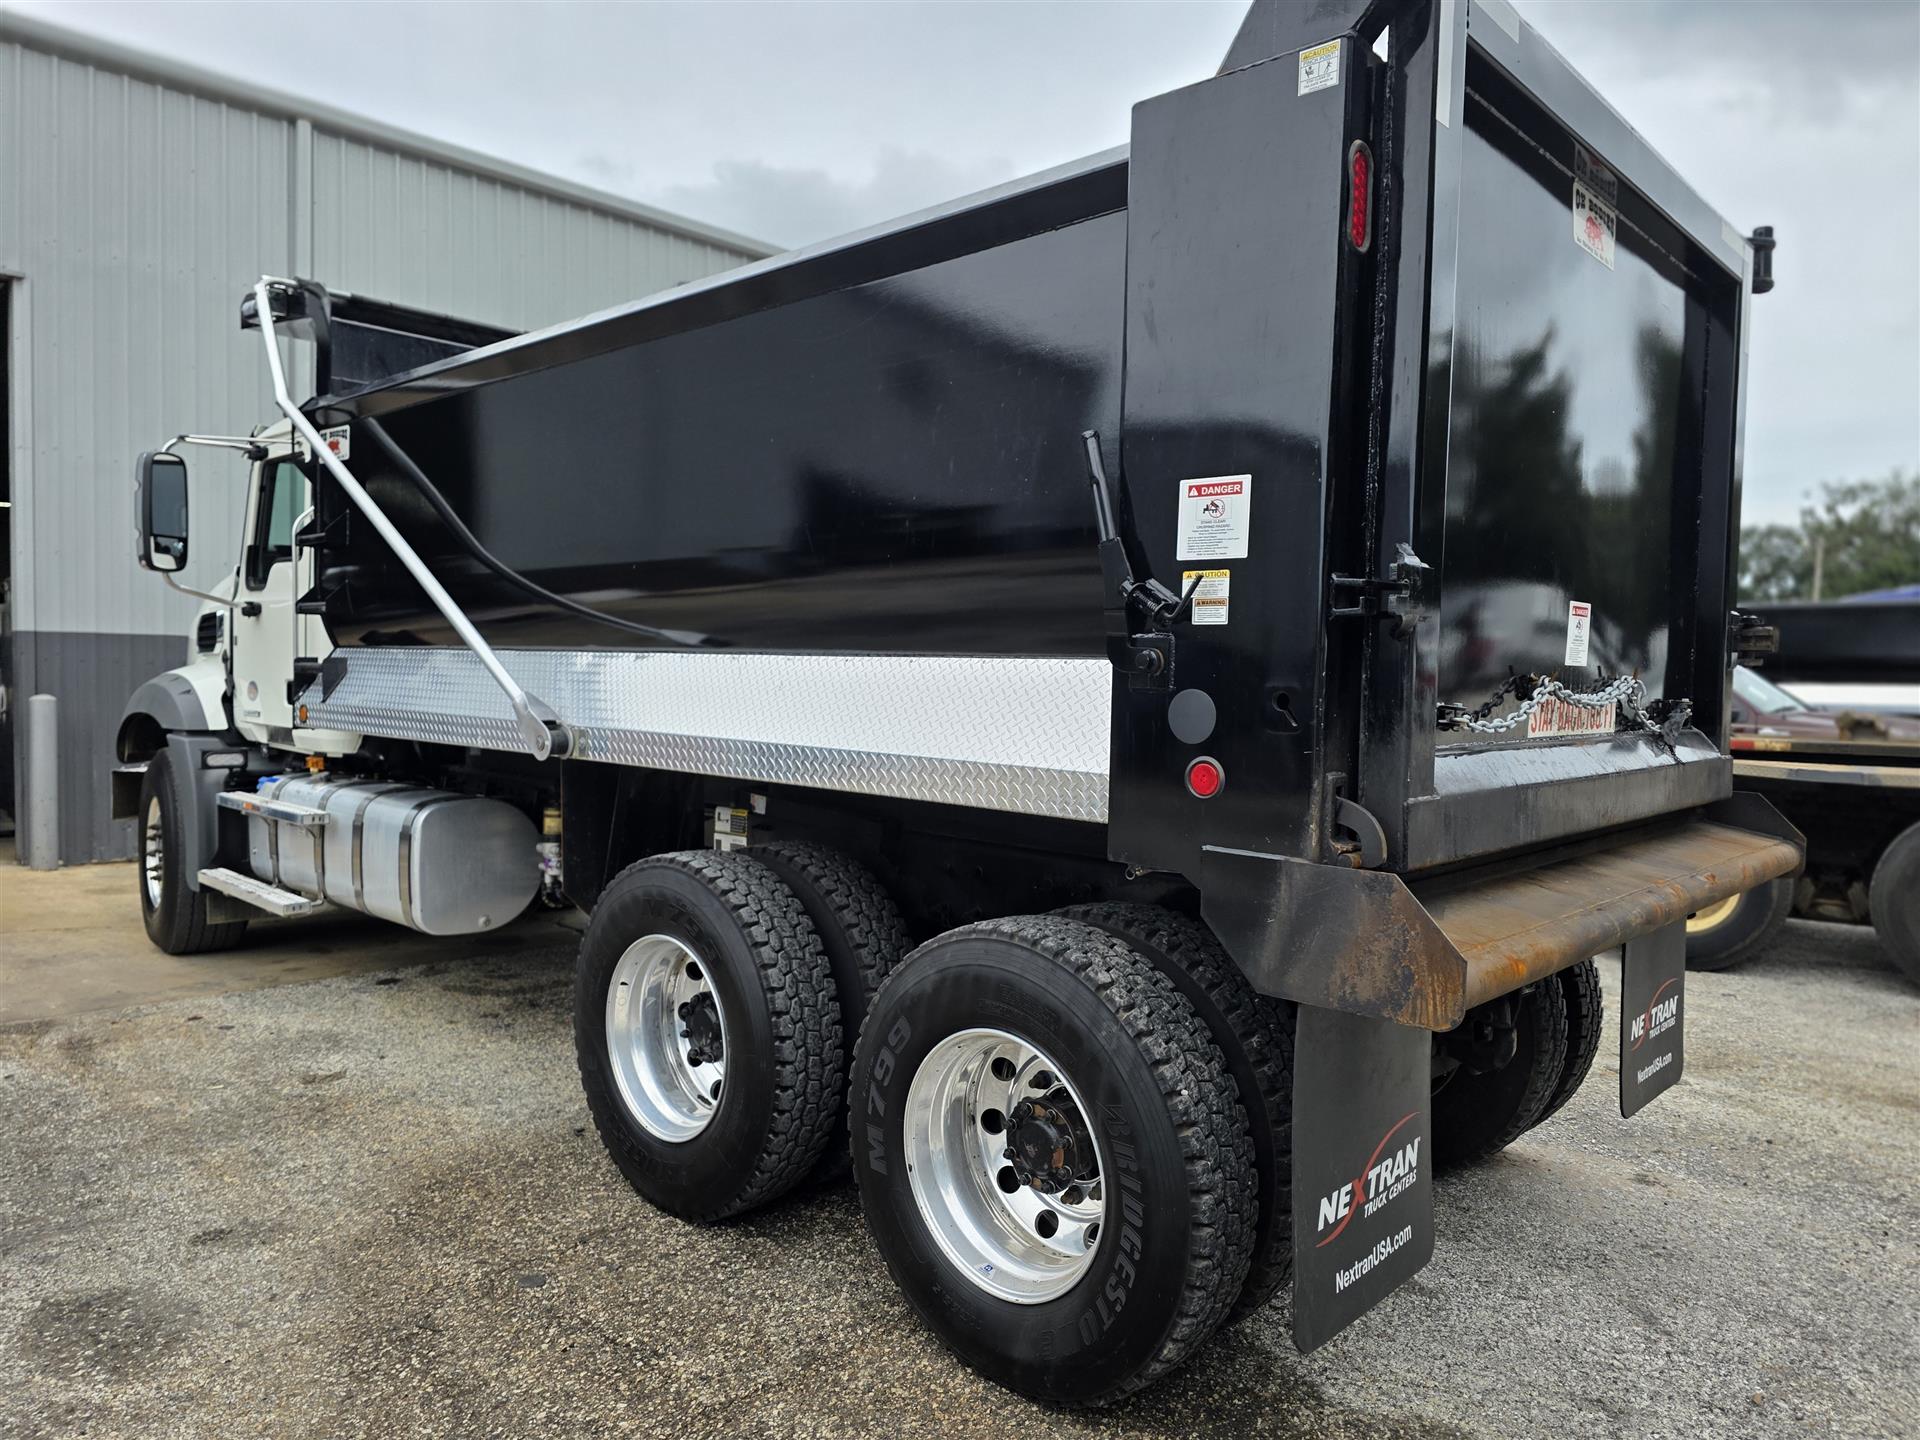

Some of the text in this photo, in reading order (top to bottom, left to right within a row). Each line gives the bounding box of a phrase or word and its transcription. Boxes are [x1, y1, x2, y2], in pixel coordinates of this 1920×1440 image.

[1307, 44, 1337, 59] CAUTION
[1201, 484, 1241, 496] DANGER
[1530, 699, 1556, 733] STAY
[1631, 995, 1678, 1041] NEXTRAN
[866, 1015, 912, 1176] M799
[1317, 1136, 1421, 1232] NEXTRAN
[1363, 1170, 1418, 1219] TRUCK CENTERS
[1068, 1104, 1146, 1350] BRIDGESTO
[1335, 1223, 1413, 1294] NextranUSA.com
